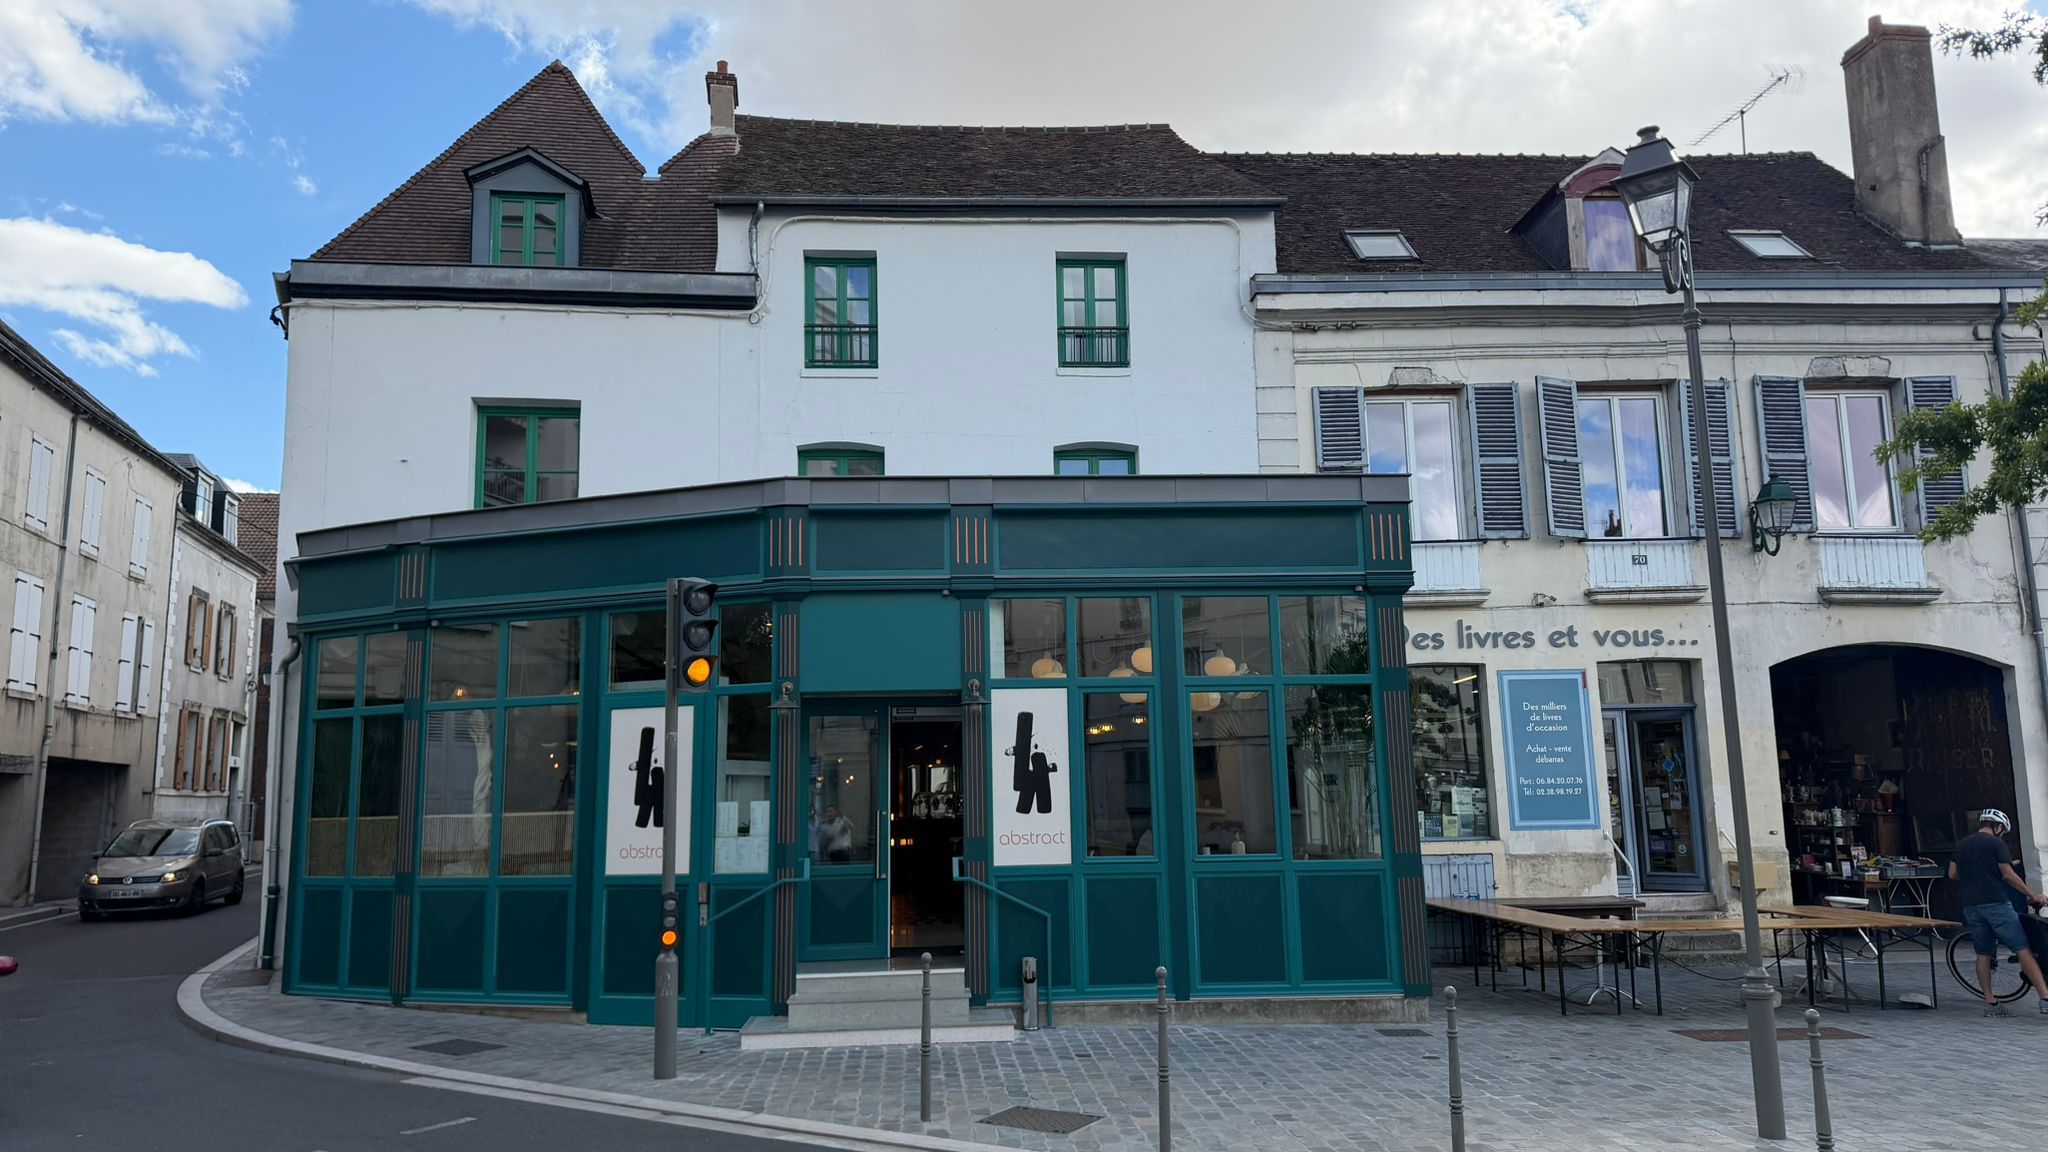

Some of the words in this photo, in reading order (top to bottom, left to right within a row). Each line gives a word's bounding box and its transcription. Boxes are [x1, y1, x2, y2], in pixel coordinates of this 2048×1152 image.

[1457, 619, 1536, 649] livres
[1548, 624, 1579, 648] et
[1593, 629, 1699, 648] vous...
[1522, 701, 1539, 711] Des
[1541, 701, 1567, 711] milliers
[1530, 712, 1541, 721] de
[1542, 712, 1562, 721] livres
[1526, 722, 1568, 732] d'occasion
[1525, 744, 1547, 753] Achat
[1553, 745, 1572, 753] vente
[1535, 754, 1564, 764] débarras
[999, 829, 1066, 846] abstract
